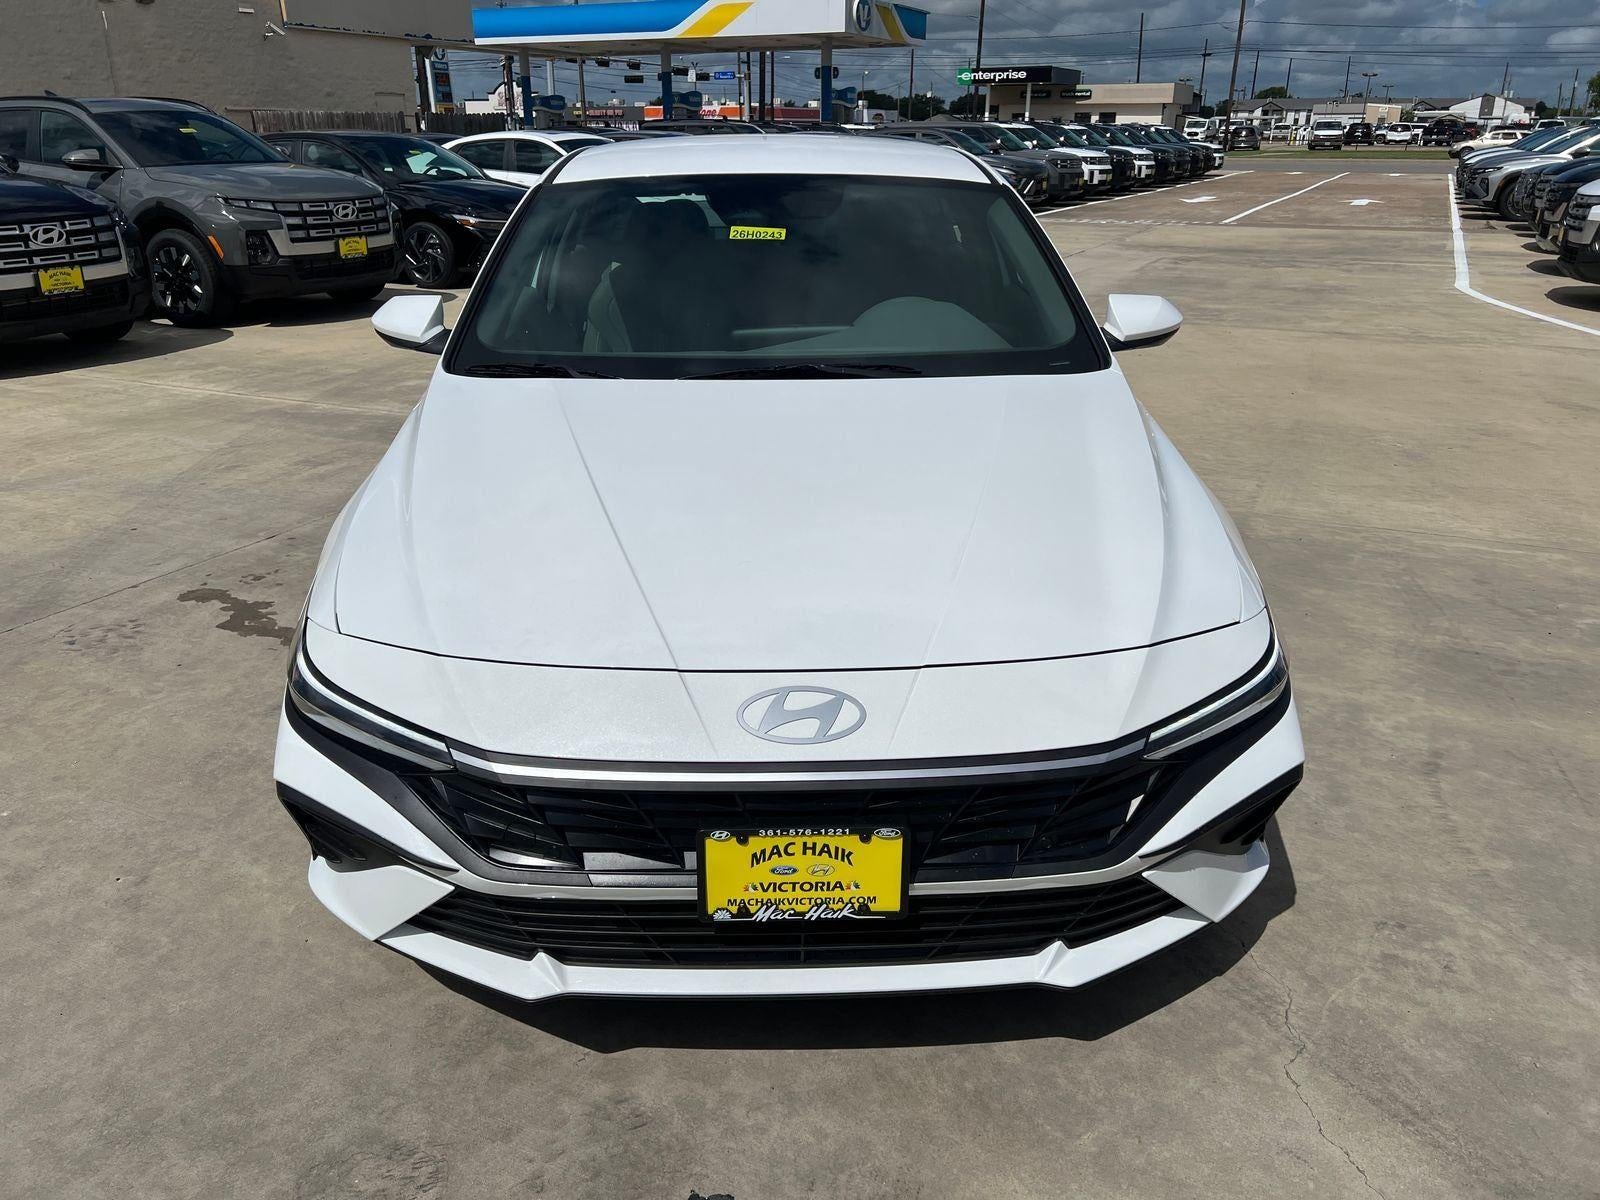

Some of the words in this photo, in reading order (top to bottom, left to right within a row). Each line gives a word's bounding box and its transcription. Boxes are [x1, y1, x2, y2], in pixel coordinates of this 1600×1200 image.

[958, 69, 1027, 82] enterprise
[732, 228, 783, 240] 26H0243
[758, 828, 851, 836] 361-576-1221
[750, 841, 797, 869] MAC
[801, 841, 855, 867] HAIK
[758, 880, 846, 893] VICTORIA
[727, 896, 877, 907] MACHAIKVICTORIA.COM
[752, 904, 803, 922] Mac
[804, 903, 856, 921] Haik
